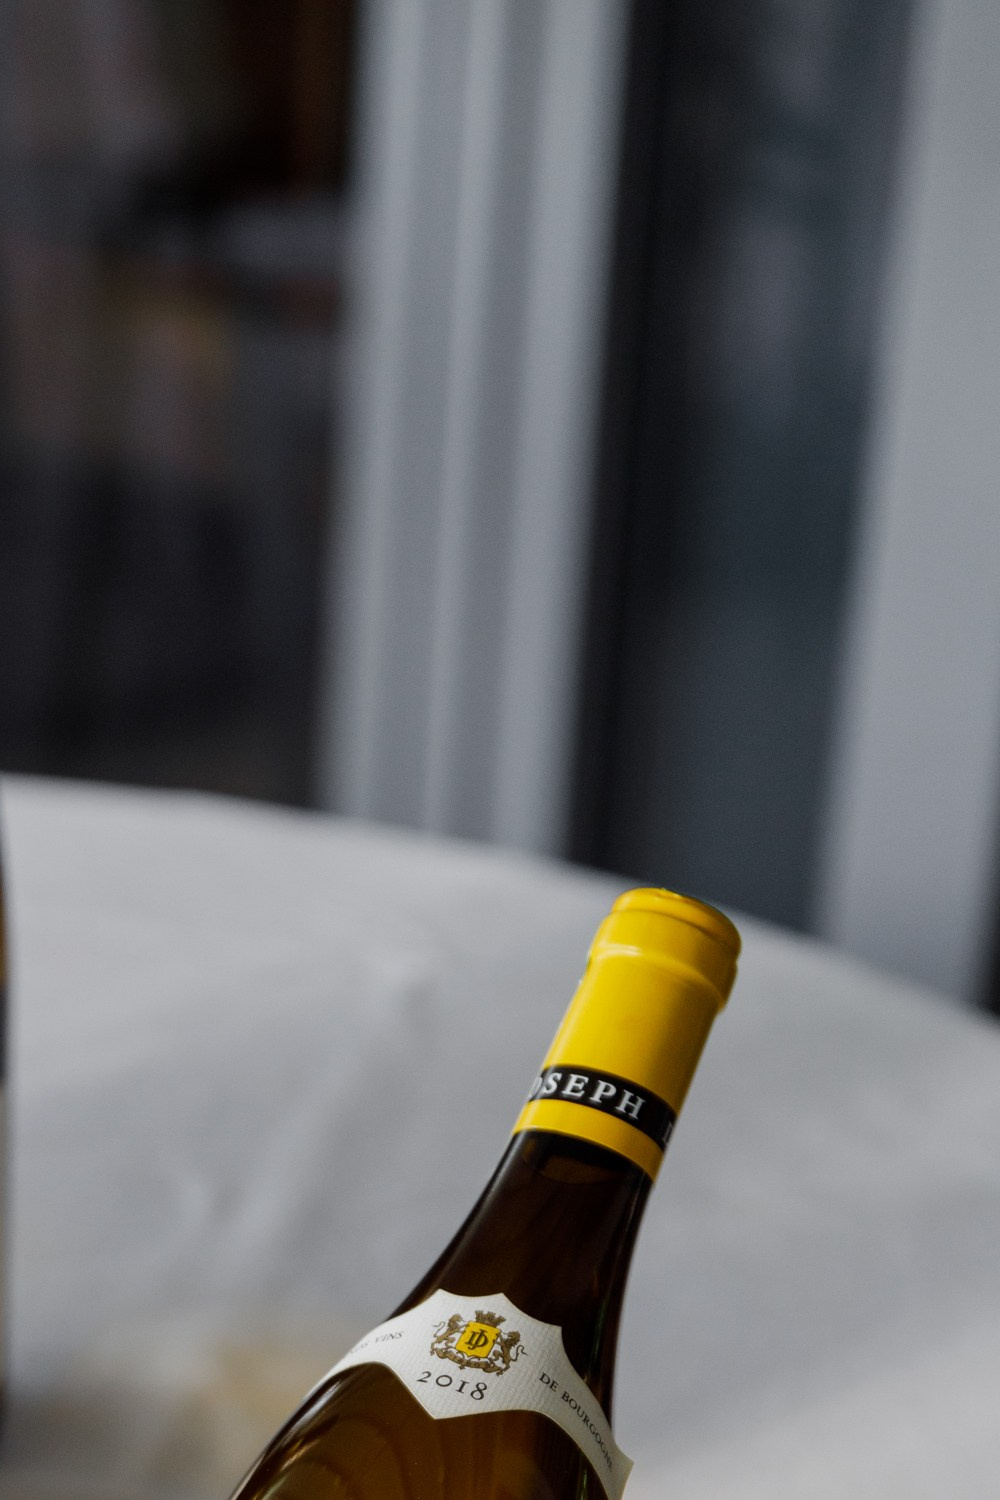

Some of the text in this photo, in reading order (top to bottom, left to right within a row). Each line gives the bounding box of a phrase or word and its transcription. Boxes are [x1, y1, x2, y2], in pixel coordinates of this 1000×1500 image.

[416, 1371, 488, 1401] 2018
[539, 1372, 613, 1472] DE BOURGOGNE
